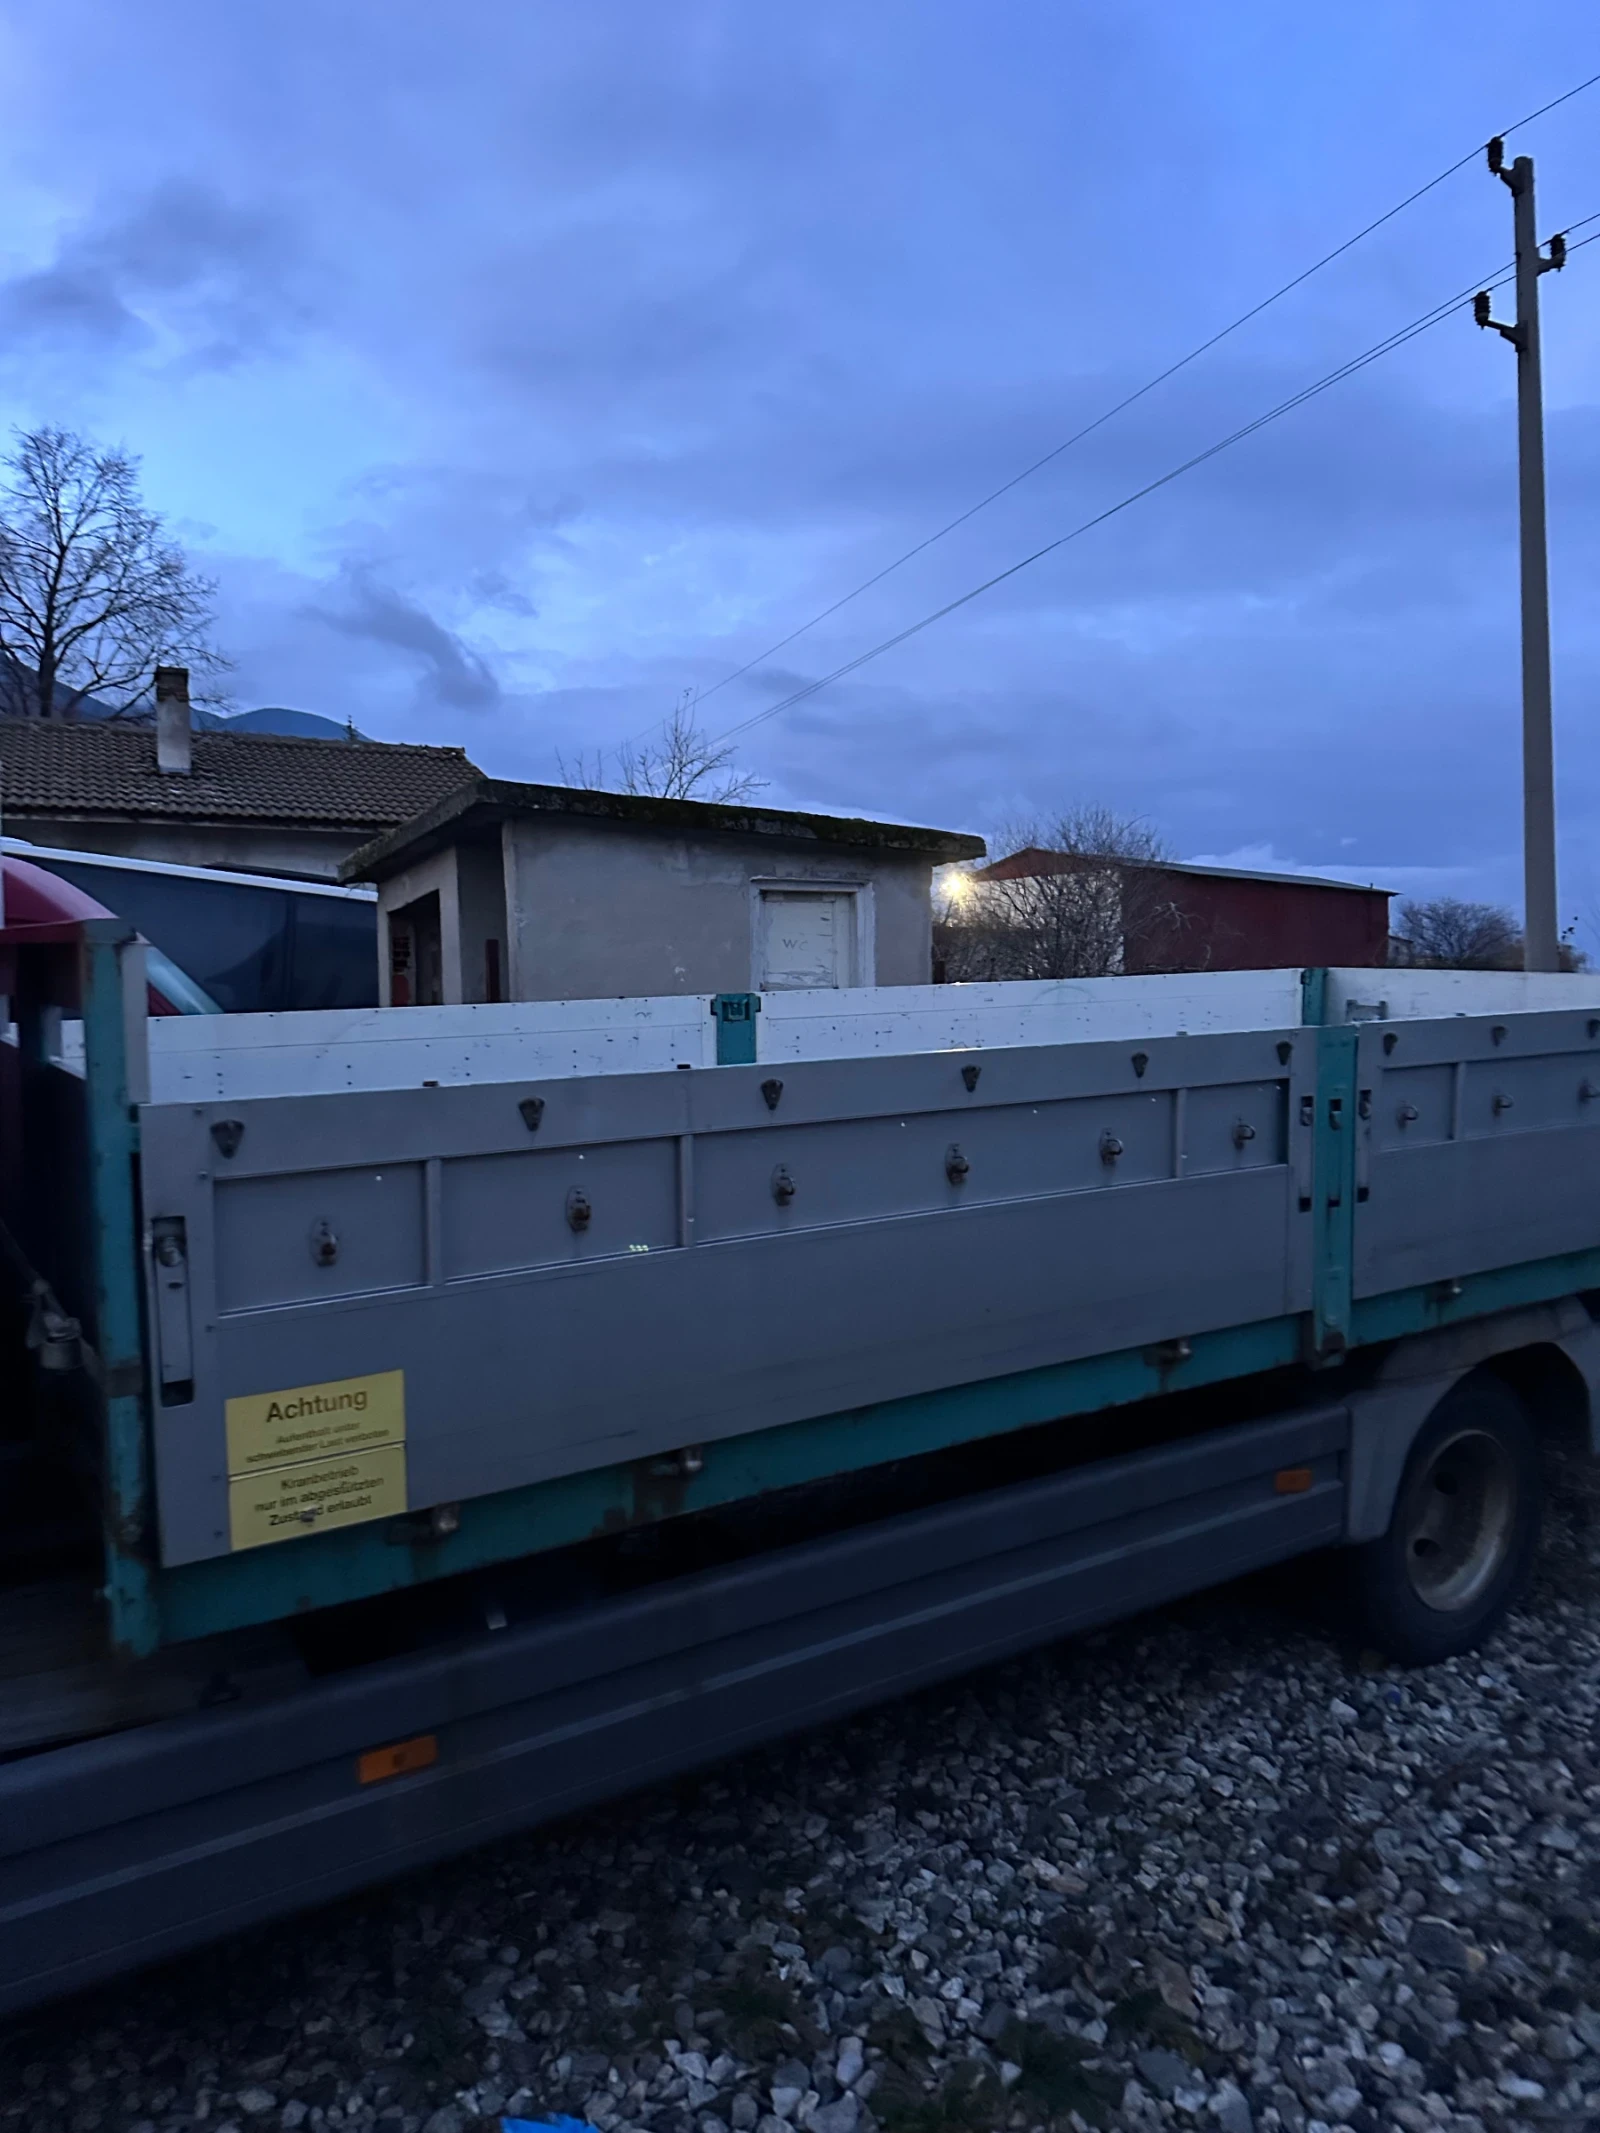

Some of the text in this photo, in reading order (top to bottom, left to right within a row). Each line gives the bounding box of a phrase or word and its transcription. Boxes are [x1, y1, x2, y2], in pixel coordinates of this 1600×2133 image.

[266, 1391, 367, 1422] Achtung
[276, 1422, 361, 1444] Aufenthalt unter
[245, 1429, 390, 1463] schwebender Last verboten
[280, 1466, 359, 1490] Kranbetrieb
[254, 1500, 278, 1512] nur
[280, 1496, 298, 1507] im
[327, 1495, 372, 1513] erlaubt
